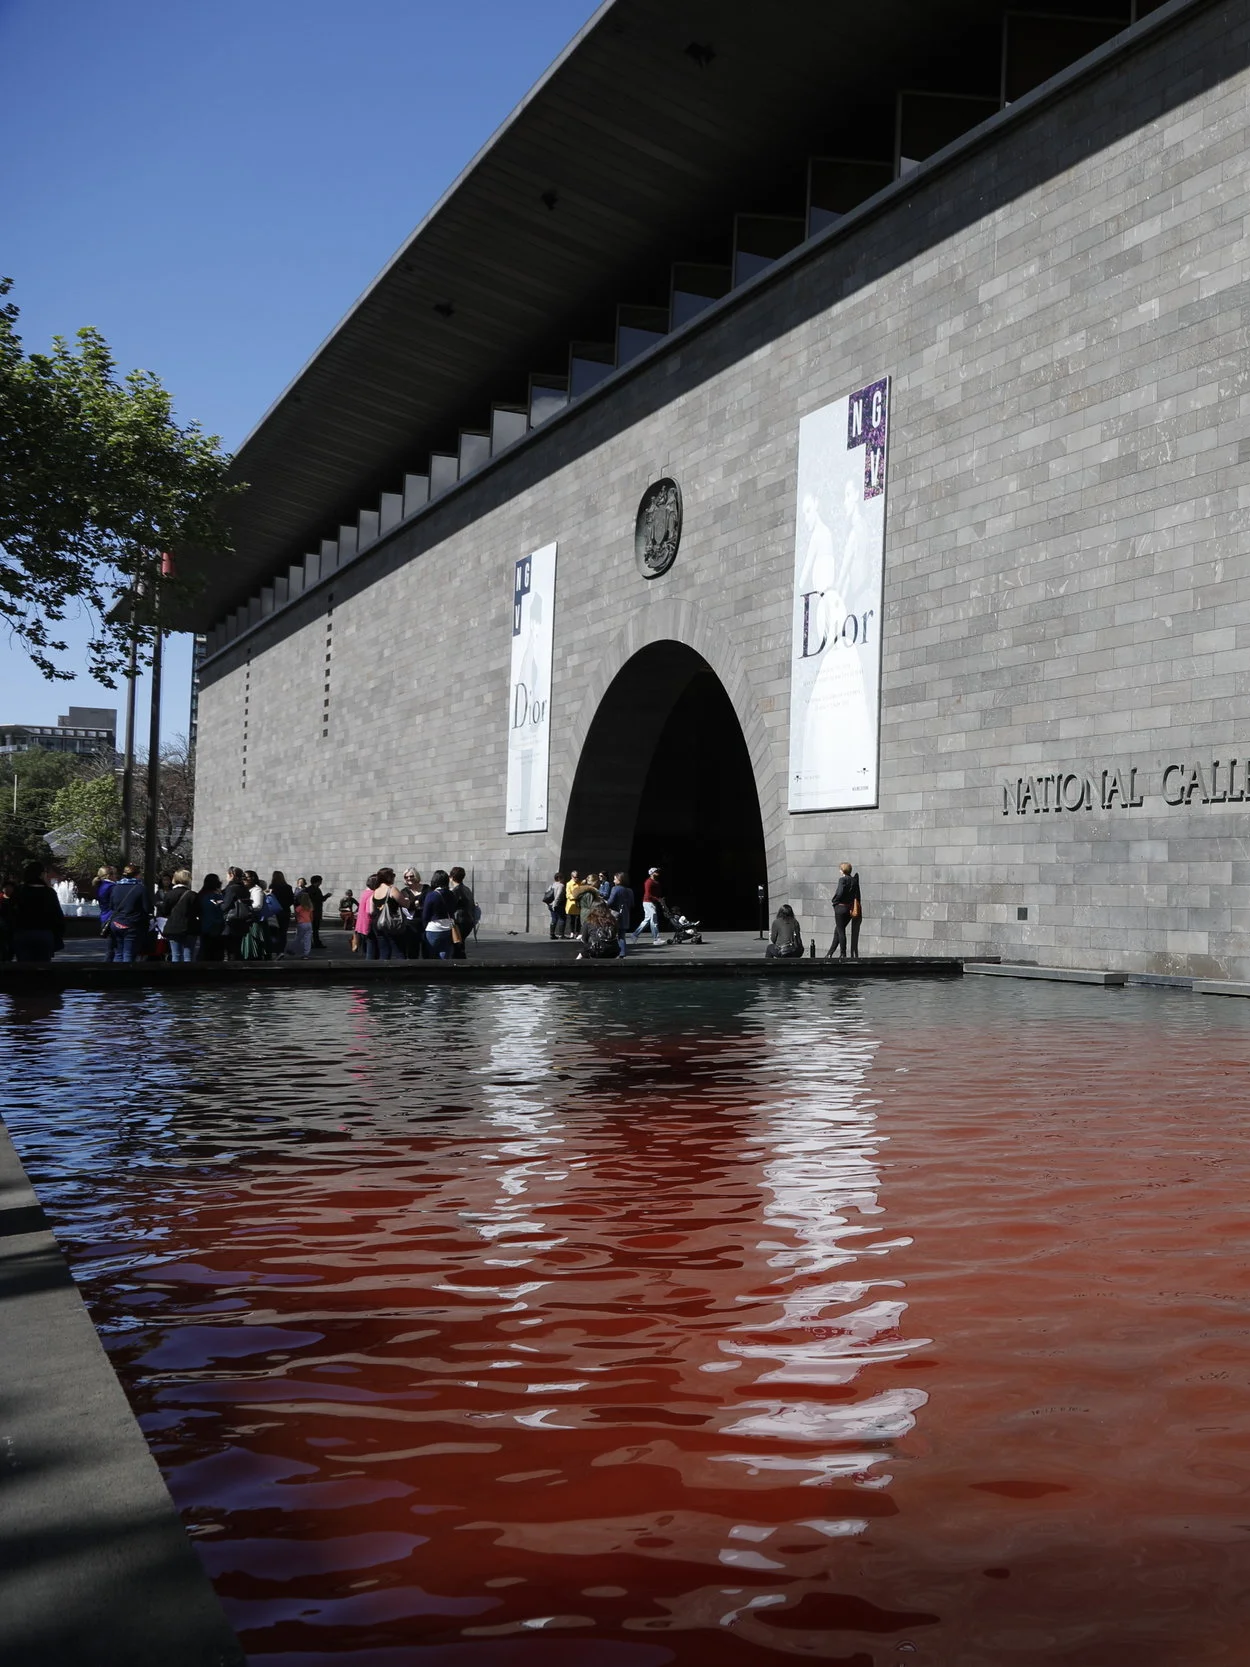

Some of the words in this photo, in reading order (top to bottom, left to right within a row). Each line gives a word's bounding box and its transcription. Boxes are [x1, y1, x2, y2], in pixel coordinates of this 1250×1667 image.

[870, 447, 881, 487] V
[515, 604, 520, 629] V
[512, 682, 547, 729] Dior
[1002, 767, 1144, 815] NATIONAL
